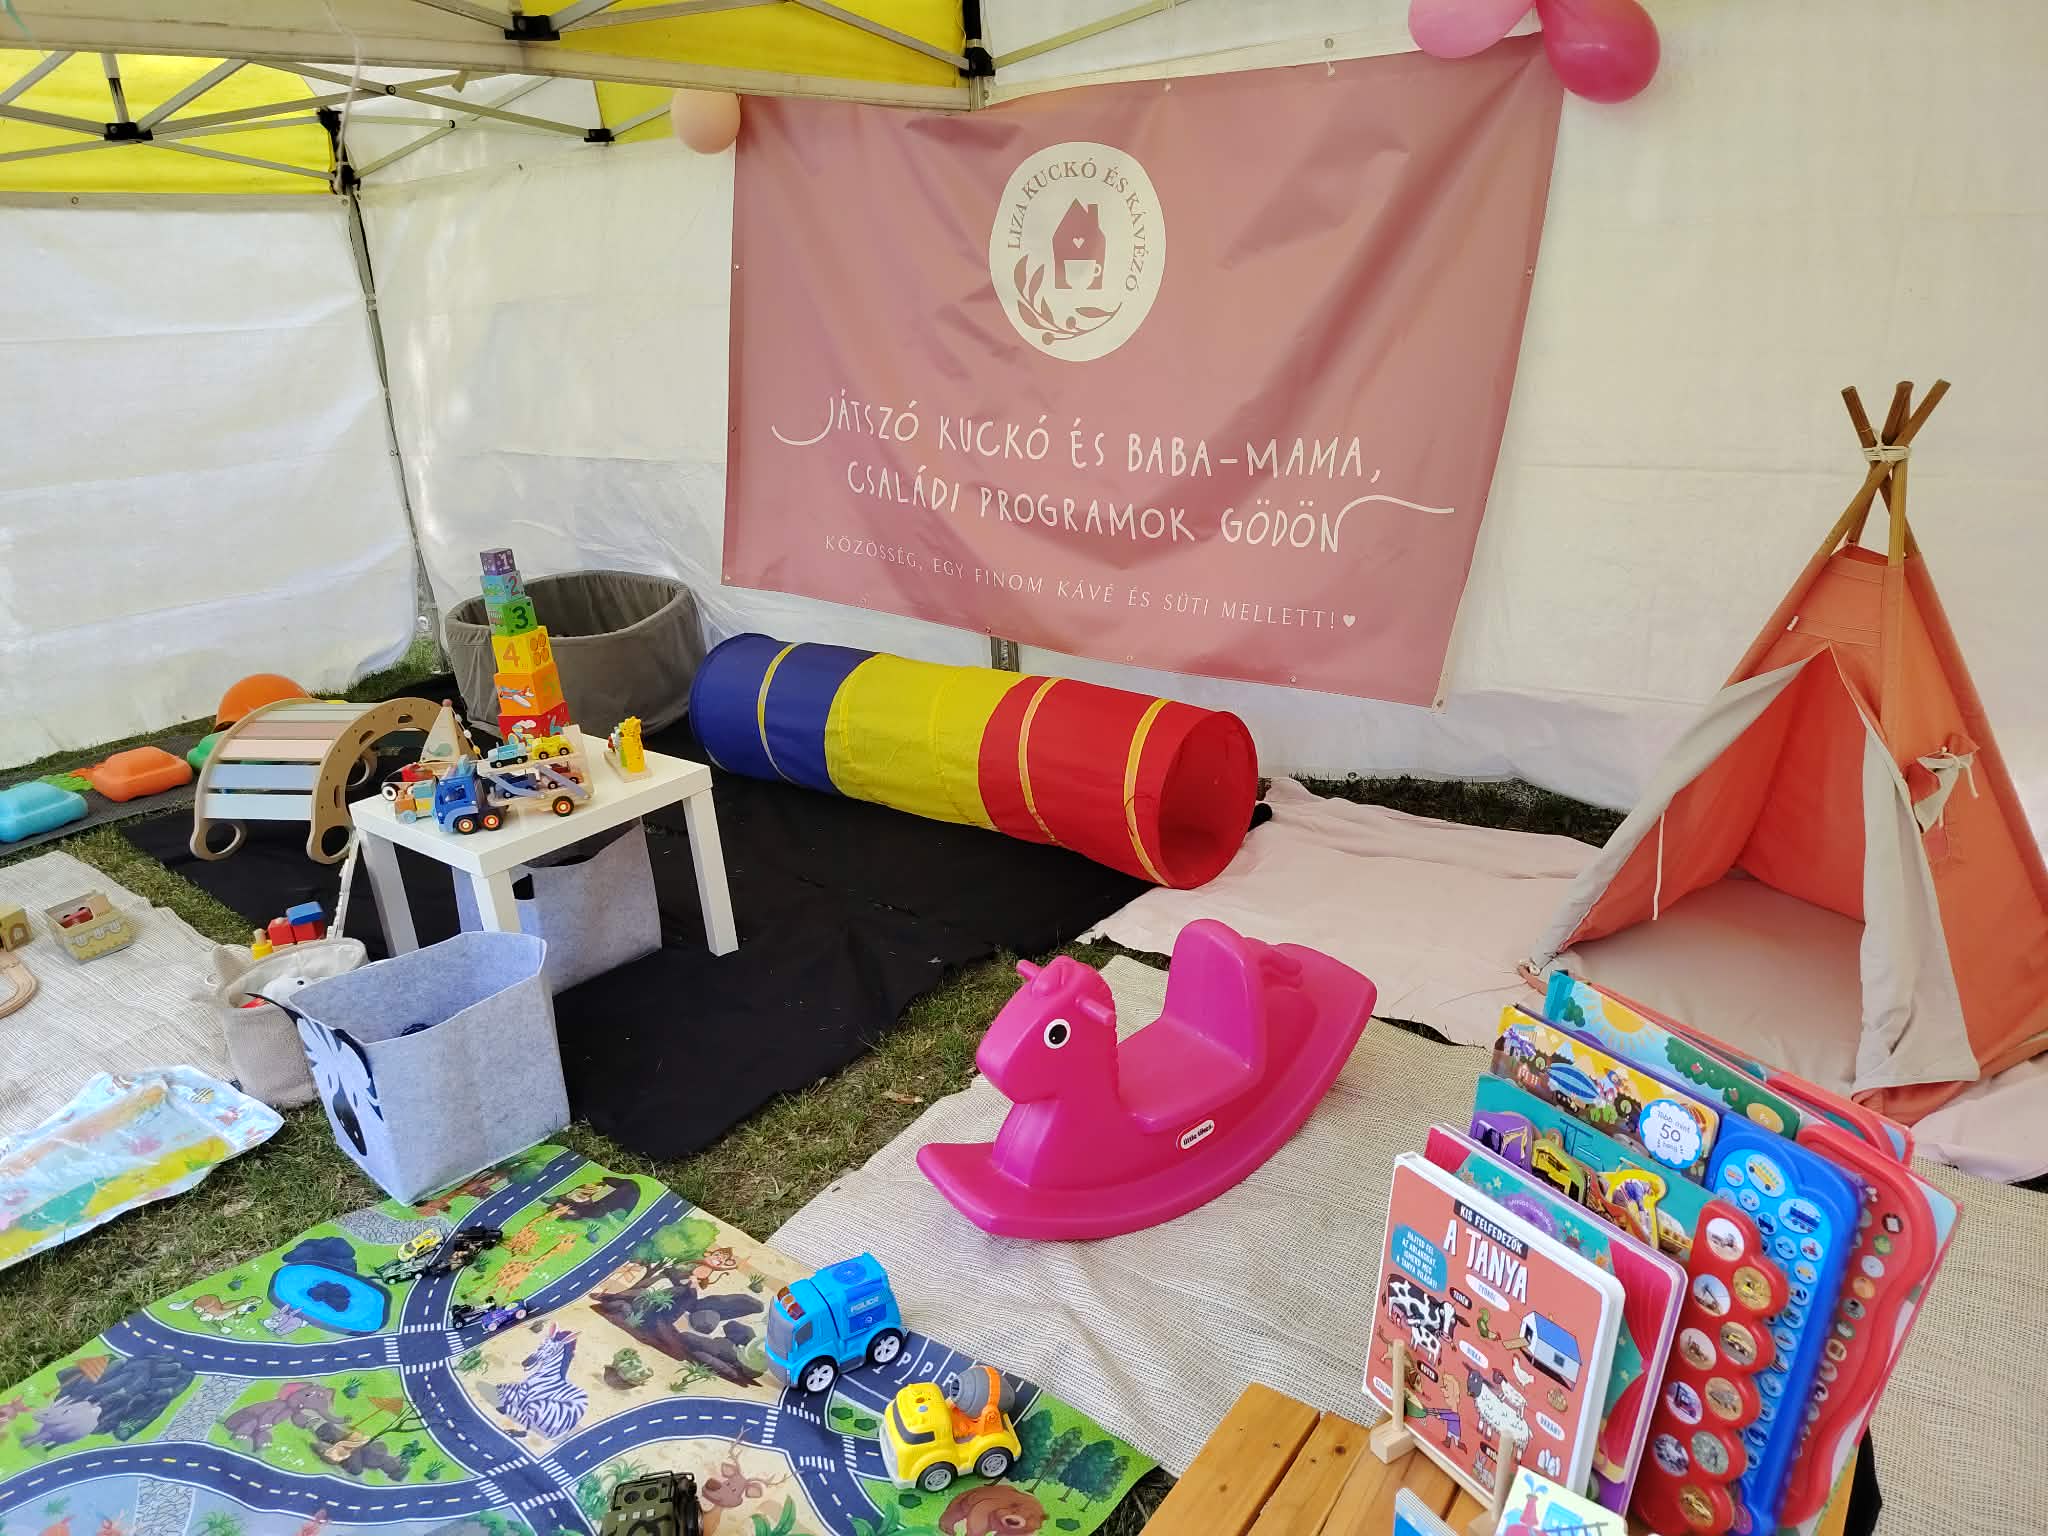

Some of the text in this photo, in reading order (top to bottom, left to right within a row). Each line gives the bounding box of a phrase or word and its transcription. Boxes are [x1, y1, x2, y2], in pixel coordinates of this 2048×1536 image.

[1008, 157, 1150, 292] LIZA KUCKÓ ÉS KÁVÉZÓ
[771, 388, 1381, 483] JÁTSZÓ KUCKÓ ÉS BABA-MAMA,
[847, 461, 1454, 552] CSALÁDI PROGRAMOK GÖDÖN
[501, 553, 510, 570] 1
[508, 575, 520, 596] 2
[825, 535, 1335, 629] KÖZÖSSÉG, EGY FINOM KÁVÉ ÉS SÜTI MELLETT!
[511, 606, 529, 630] 3
[503, 642, 520, 668] 4
[1660, 1123, 1680, 1142] 50
[1460, 1205, 1473, 1222] KIS
[1443, 1219, 1528, 1304] A TANYA
[896, 1351, 912, 1367] P
[918, 1361, 934, 1377] P
